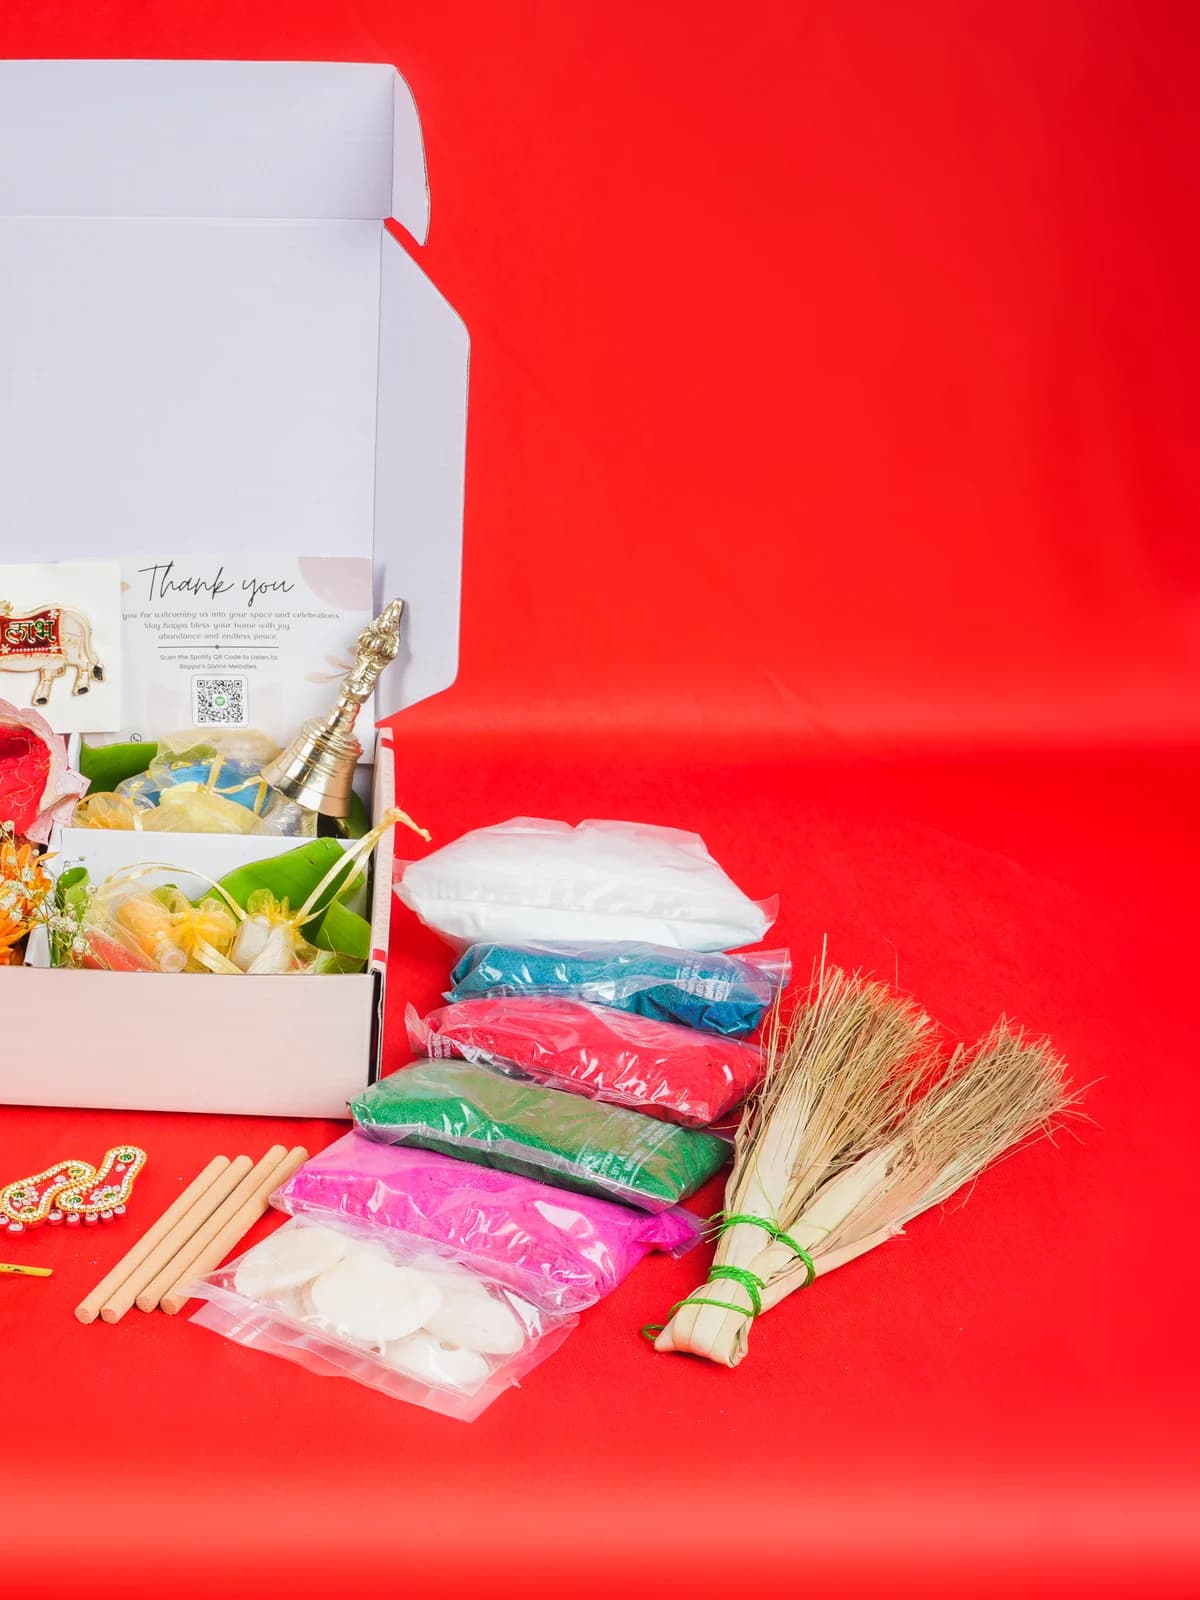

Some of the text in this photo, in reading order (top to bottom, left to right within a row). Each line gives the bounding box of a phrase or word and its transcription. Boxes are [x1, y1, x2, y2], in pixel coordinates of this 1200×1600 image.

[137, 561, 295, 608] Thank you
[122, 613, 137, 621] you
[154, 611, 197, 619] welcoming
[5, 618, 55, 643] लाभ
[144, 622, 160, 630] May
[163, 622, 188, 630] Bappa
[213, 622, 231, 630] your
[258, 621, 274, 629] with
[222, 632, 251, 640] endless
